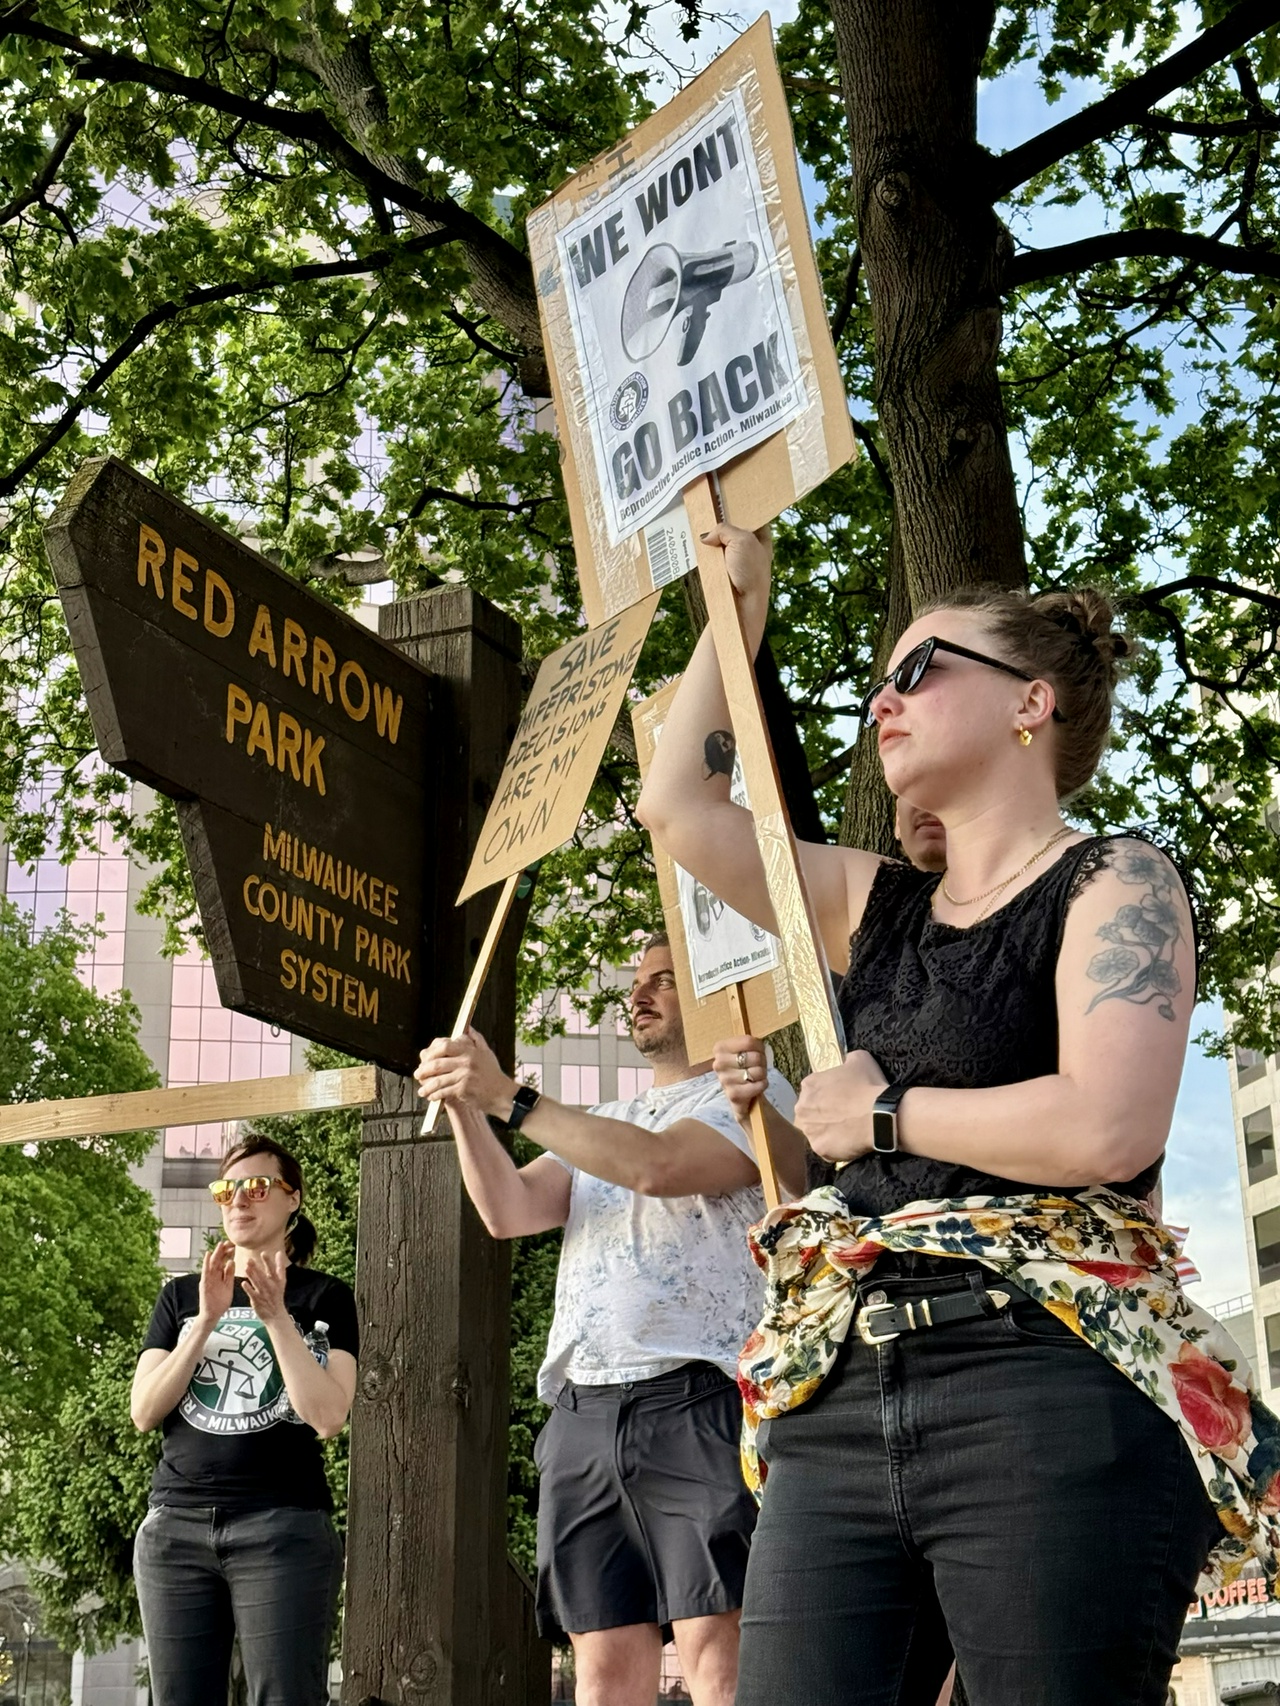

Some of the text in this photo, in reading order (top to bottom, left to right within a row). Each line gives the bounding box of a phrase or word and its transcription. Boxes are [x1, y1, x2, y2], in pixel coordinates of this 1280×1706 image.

[567, 210, 629, 289] WE
[634, 115, 740, 237] WONT
[611, 421, 663, 500] GO
[667, 331, 789, 453] BACK
[671, 446, 701, 477] Justice
[137, 522, 403, 745] RED ARROW
[550, 618, 621, 692] SAVE
[225, 681, 327, 797] PARK
[494, 732, 589, 817] ARE MY
[263, 821, 400, 925] MILWAUKEE
[483, 784, 562, 865] OWN
[242, 875, 412, 985] COUNTY PARK
[280, 948, 380, 1024] SYSTEM
